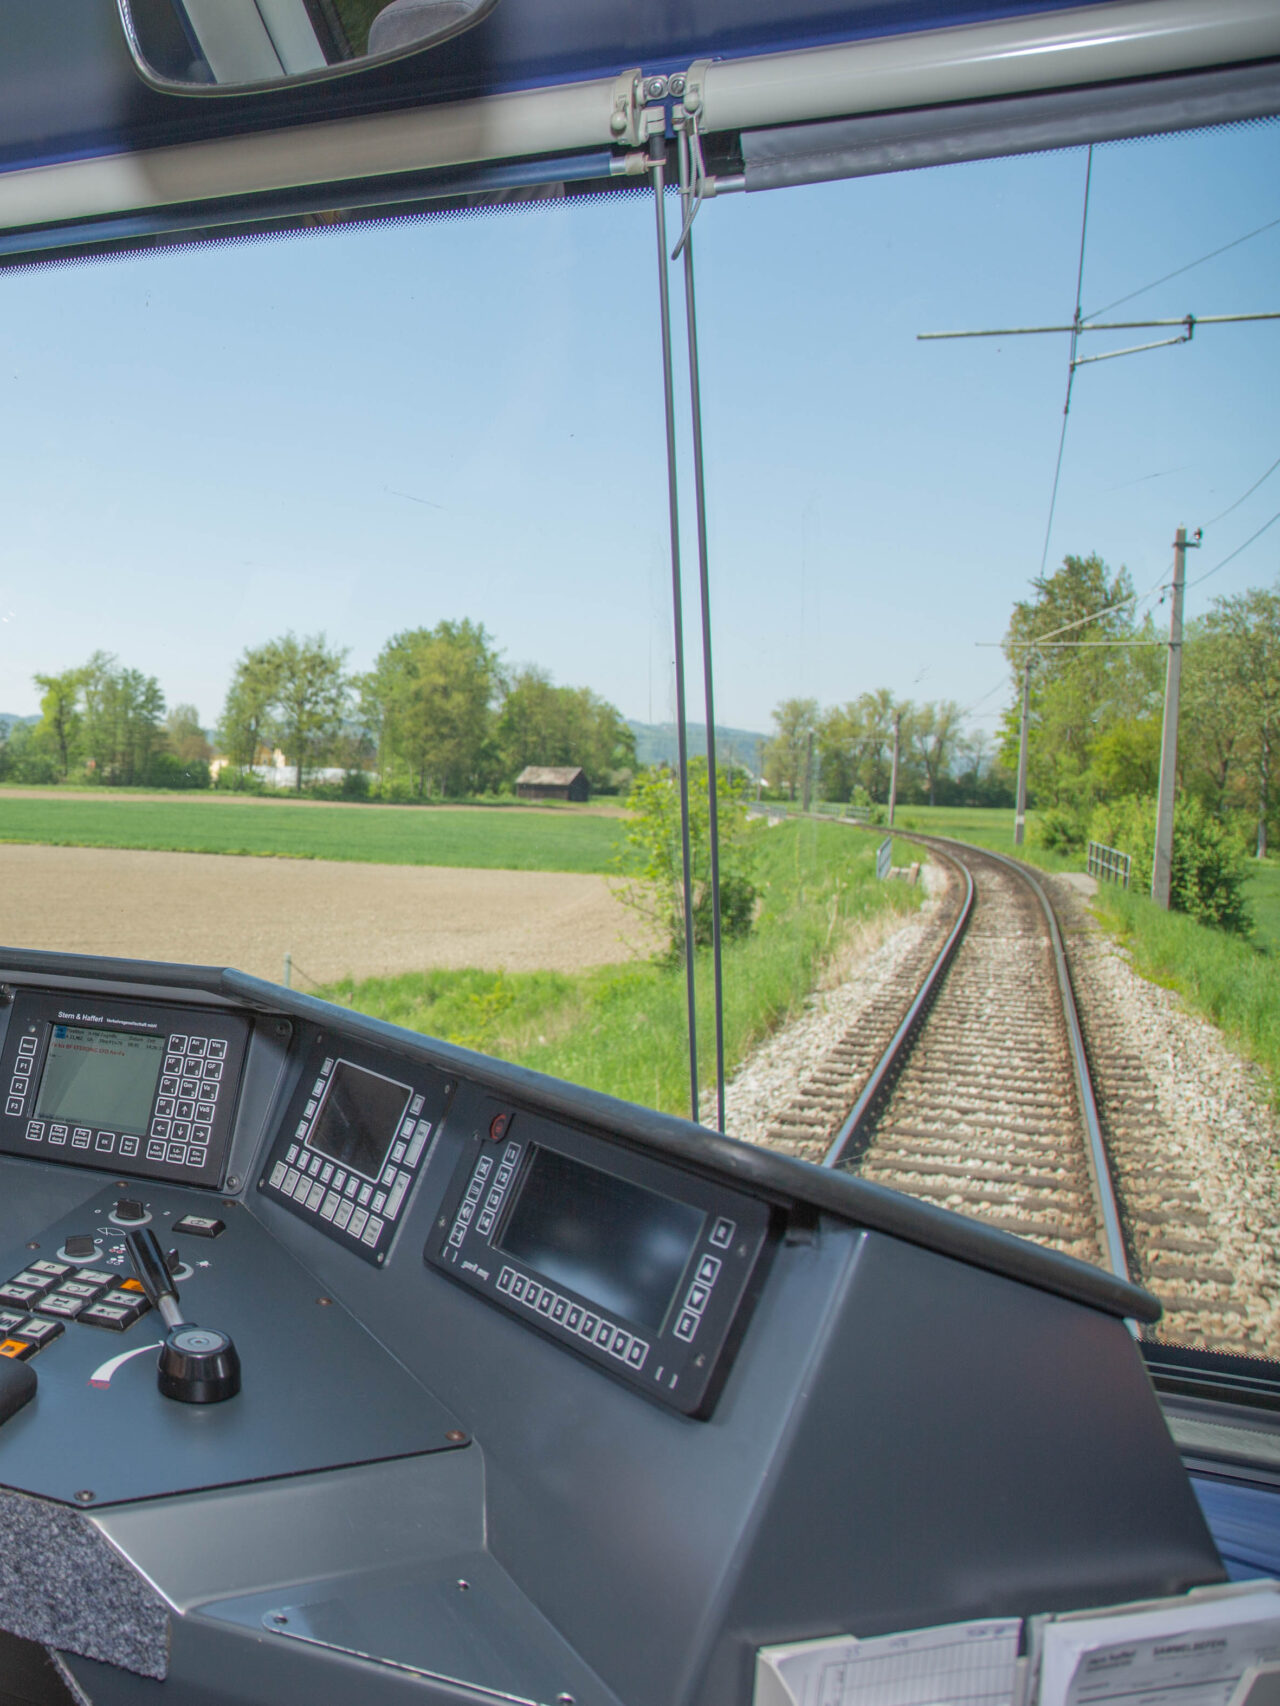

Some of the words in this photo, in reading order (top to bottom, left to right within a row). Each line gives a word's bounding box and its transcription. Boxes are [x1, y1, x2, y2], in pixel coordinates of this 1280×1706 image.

[58, 1011, 75, 1020] Stern
[82, 1014, 104, 1023] Hafferl
[718, 1226, 727, 1239] R
[502, 1274, 508, 1284] 1
[515, 1282, 522, 1292] 2
[528, 1289, 536, 1299] 3
[542, 1297, 549, 1307] 4
[556, 1305, 563, 1315] 5
[570, 1313, 577, 1324] 6
[585, 1320, 593, 1331] 7
[681, 1319, 691, 1332] E
[600, 1329, 608, 1340] 8
[616, 1339, 624, 1349] 9
[631, 1347, 640, 1359] 0
